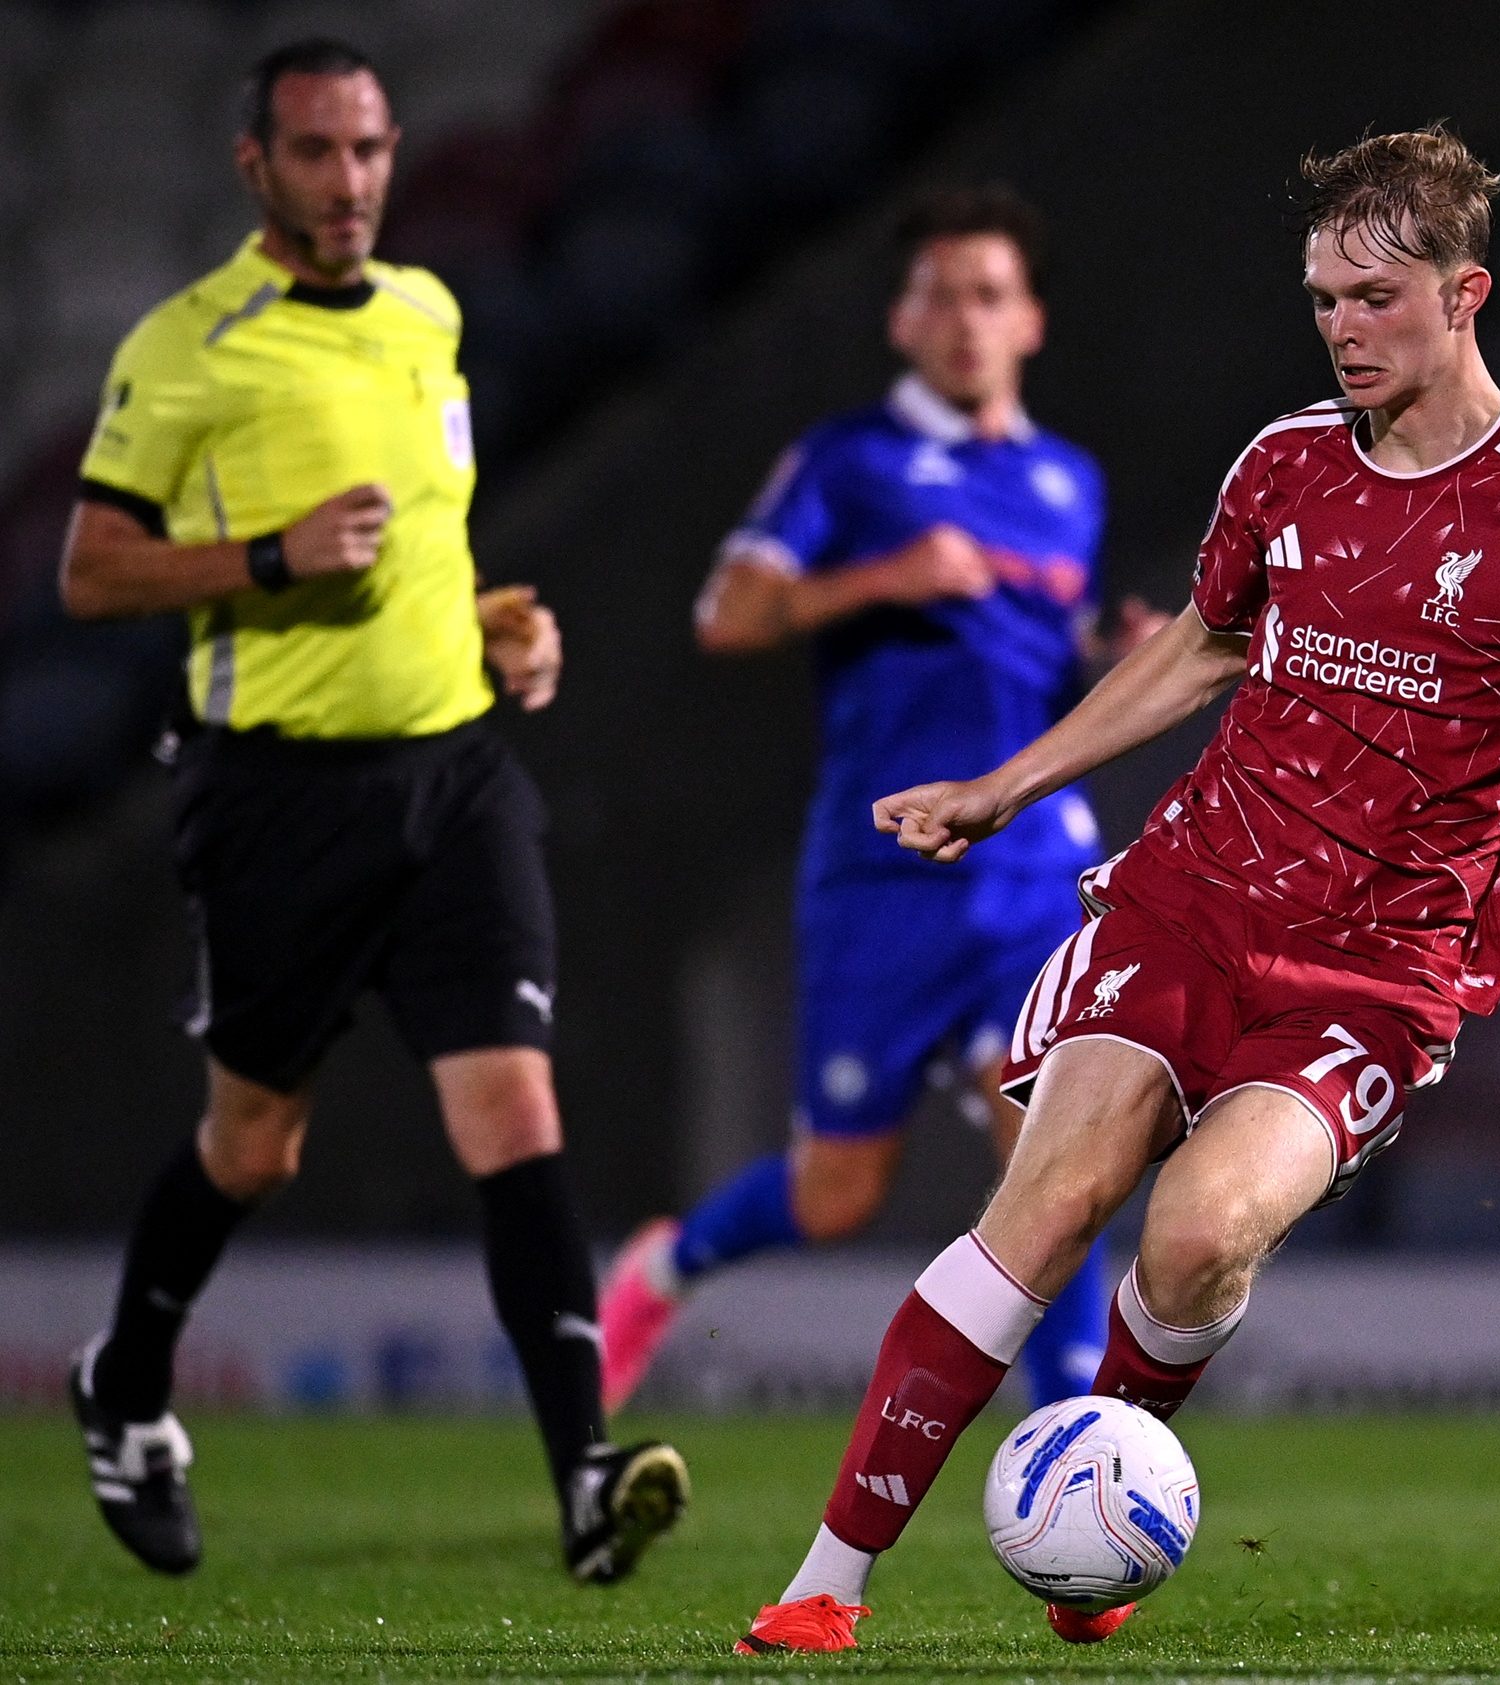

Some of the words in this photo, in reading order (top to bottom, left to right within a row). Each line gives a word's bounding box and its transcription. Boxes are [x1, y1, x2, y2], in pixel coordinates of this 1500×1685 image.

[1290, 625, 1436, 675] standard
[1286, 652, 1443, 704] chartered
[1298, 1023, 1396, 1135] 79
[881, 1396, 946, 1440] LFC
